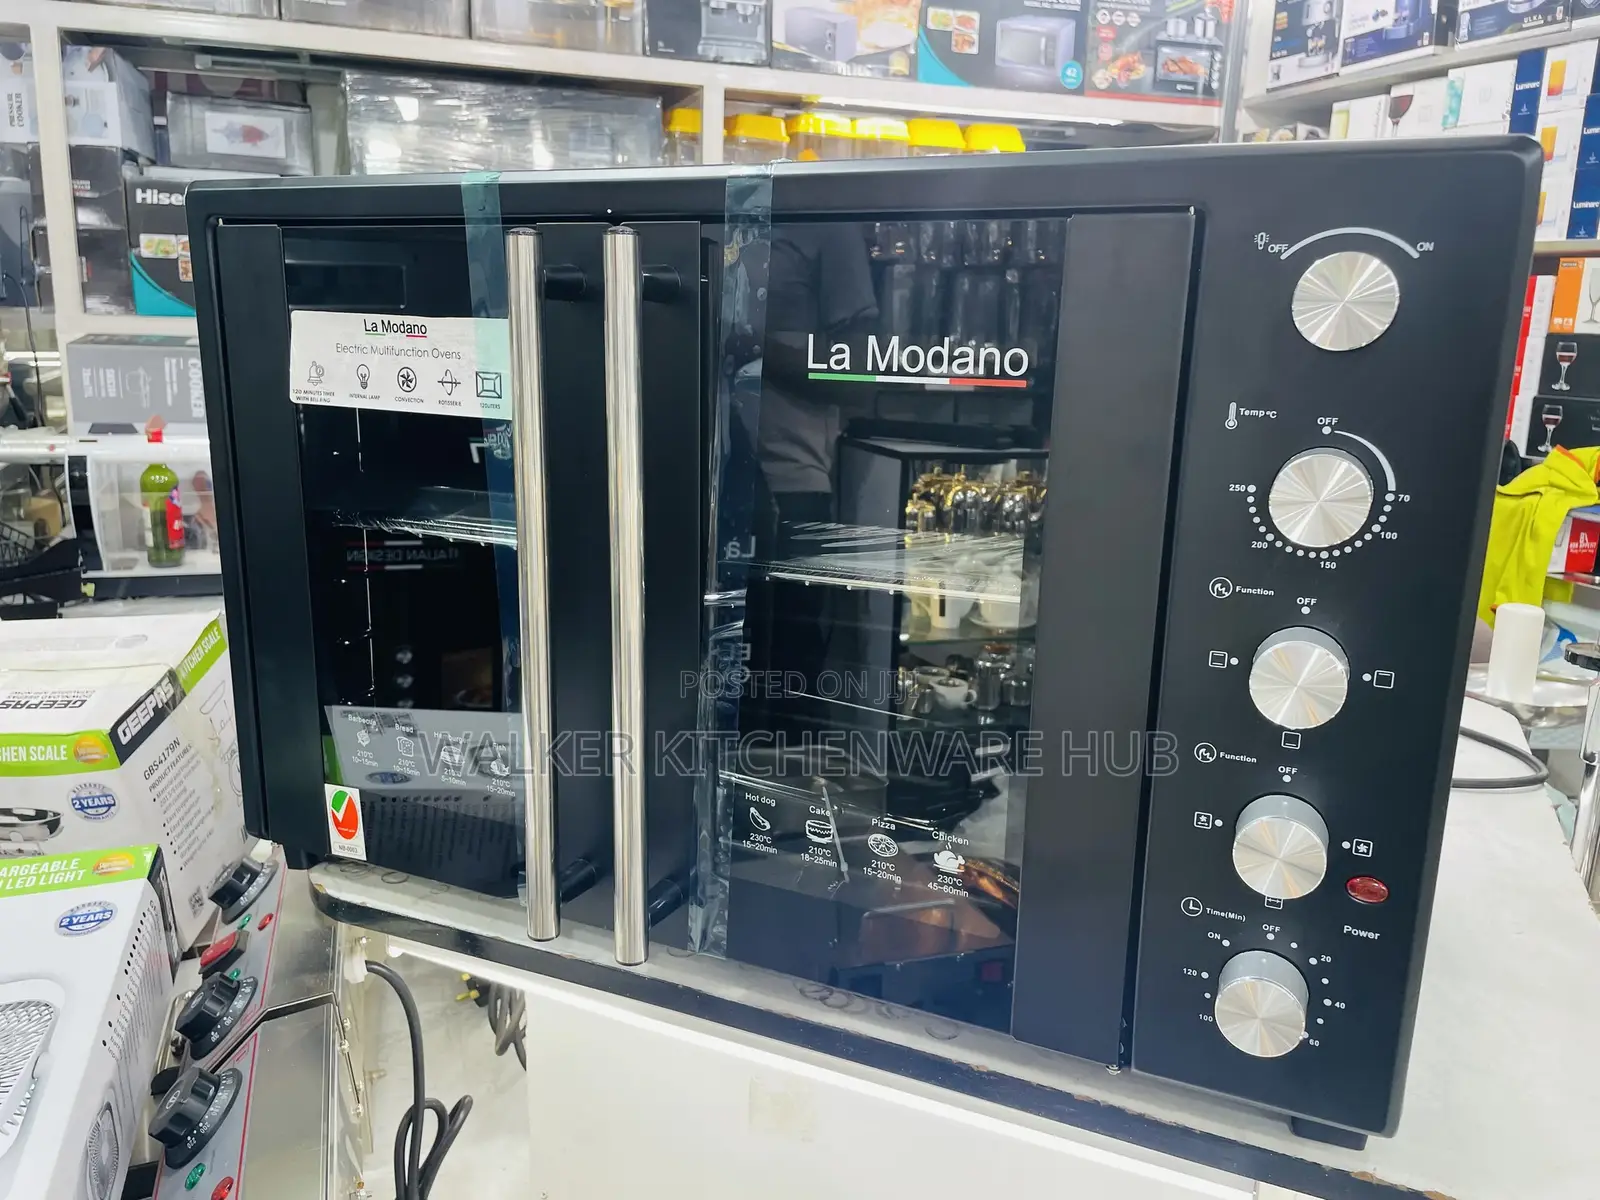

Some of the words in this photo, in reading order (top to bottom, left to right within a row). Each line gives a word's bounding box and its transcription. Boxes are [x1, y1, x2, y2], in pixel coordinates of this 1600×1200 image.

[1515, 81, 1540, 91] Luminarc
[1267, 244, 1289, 253] OFF
[1417, 241, 1435, 251] ON
[363, 318, 378, 333] La
[381, 319, 428, 335] Modano
[335, 342, 368, 355] Electric
[370, 344, 430, 358] Multifunction
[432, 347, 462, 360] Ovens
[807, 333, 851, 371] La
[867, 334, 1029, 377] Modano
[394, 396, 424, 404] CONVECTION
[1317, 417, 1339, 426] OFF
[1229, 484, 1246, 492] 250
[1398, 494, 1410, 502] 70
[1380, 531, 1398, 540] 100
[1251, 541, 1268, 549] 200
[1319, 561, 1337, 569] 150
[1236, 585, 1275, 596] Function
[1296, 597, 1317, 606] OFF
[202, 627, 221, 653] SCALE
[117, 677, 174, 746] GEEPAS
[395, 723, 414, 733] Bread
[29, 744, 68, 761] SCALE
[1220, 751, 1257, 763] Function
[143, 736, 181, 781] GBS4179N
[1278, 765, 1298, 774] OFF
[73, 800, 81, 809] 2
[80, 796, 115, 808] YEARS
[745, 792, 760, 803] Hot
[760, 796, 776, 808] dog
[809, 805, 831, 817] Cake
[871, 816, 896, 831] Pizza
[931, 830, 969, 846] Chicken
[5, 877, 36, 890] LED
[40, 869, 87, 886] LIGHT
[61, 918, 70, 926] 2
[72, 911, 112, 924] YEARS
[1205, 907, 1246, 922] Time(Min)
[1262, 924, 1281, 933] OFF
[1343, 925, 1381, 940] Power
[1207, 931, 1221, 940] ON
[1321, 955, 1332, 963] 20
[1182, 967, 1198, 976] 120
[1335, 1001, 1346, 1010] 40
[1199, 1013, 1214, 1022] 100
[1309, 1039, 1320, 1047] 60
